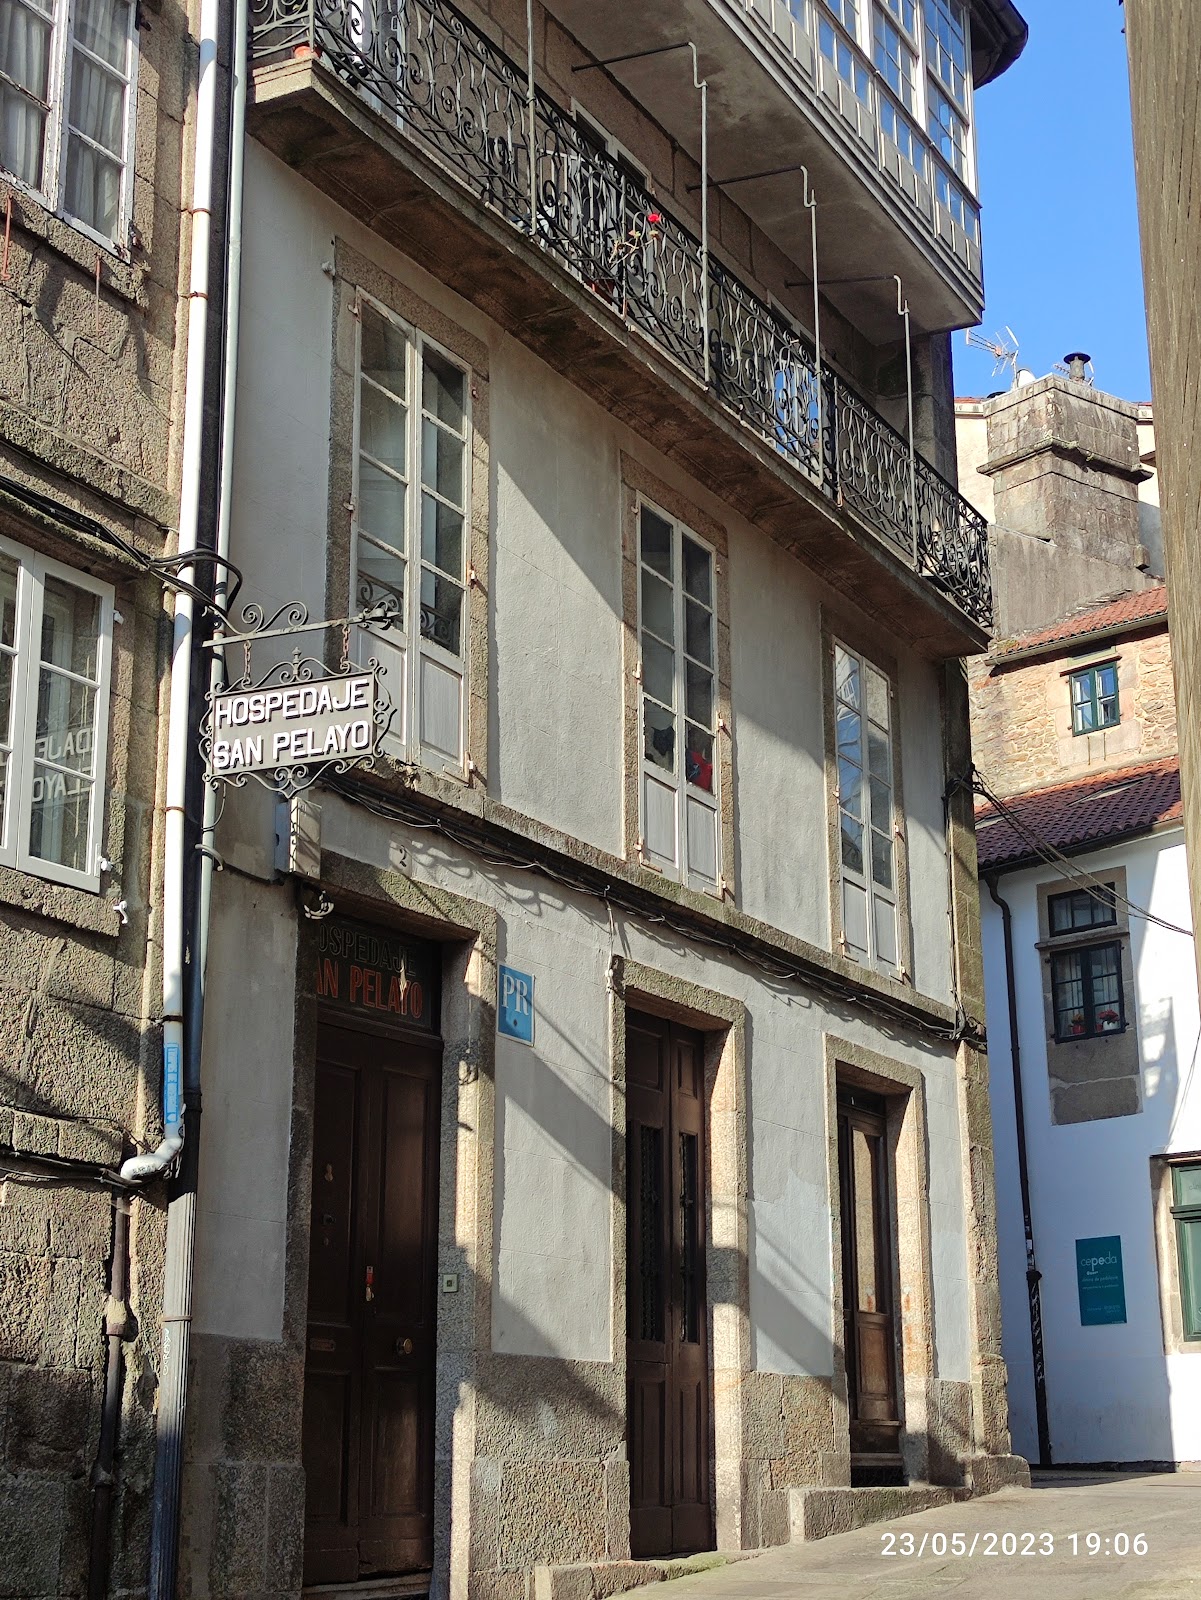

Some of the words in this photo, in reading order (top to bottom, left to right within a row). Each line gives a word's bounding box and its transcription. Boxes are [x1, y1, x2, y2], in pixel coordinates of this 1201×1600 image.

[214, 678, 370, 728] HOSPEDAJE
[213, 735, 263, 769] SAN
[272, 720, 370, 761] PELAYO
[318, 922, 417, 977] OSPEDAJE
[349, 964, 424, 1019] PELAYO
[501, 972, 530, 1016] PR
[1080, 1250, 1118, 1272] cepeda
